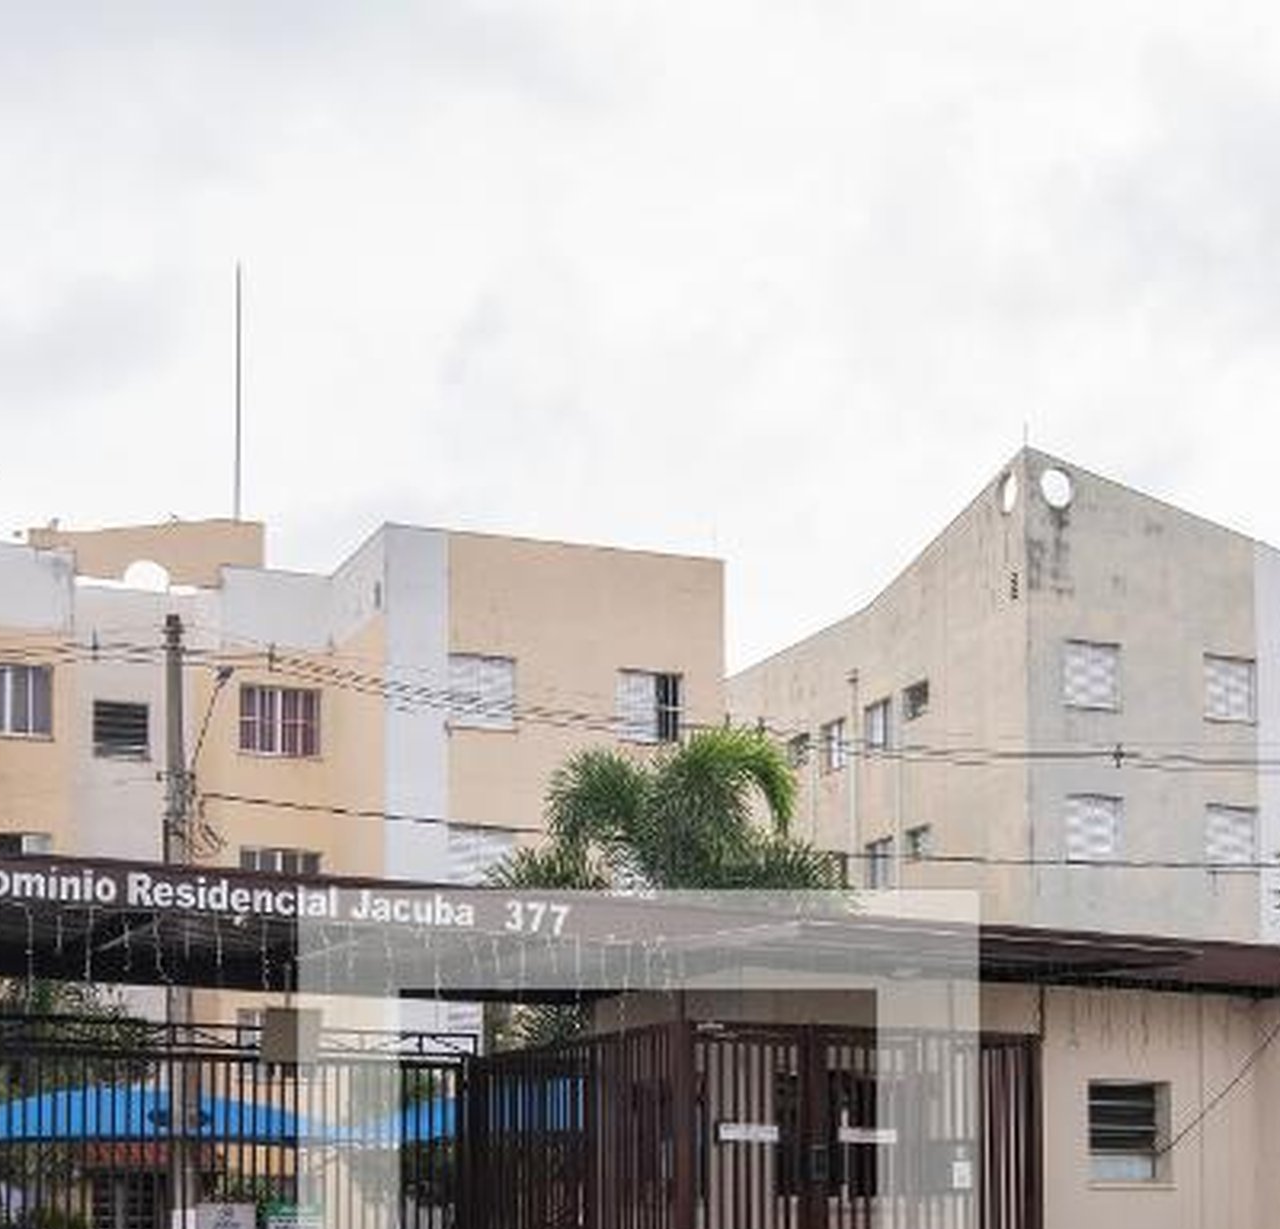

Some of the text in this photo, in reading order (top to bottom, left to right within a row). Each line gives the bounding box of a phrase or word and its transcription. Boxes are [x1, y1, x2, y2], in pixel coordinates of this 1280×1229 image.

[126, 871, 339, 919] Residencial
[350, 890, 474, 927] Jacuba
[504, 901, 570, 937] 377
